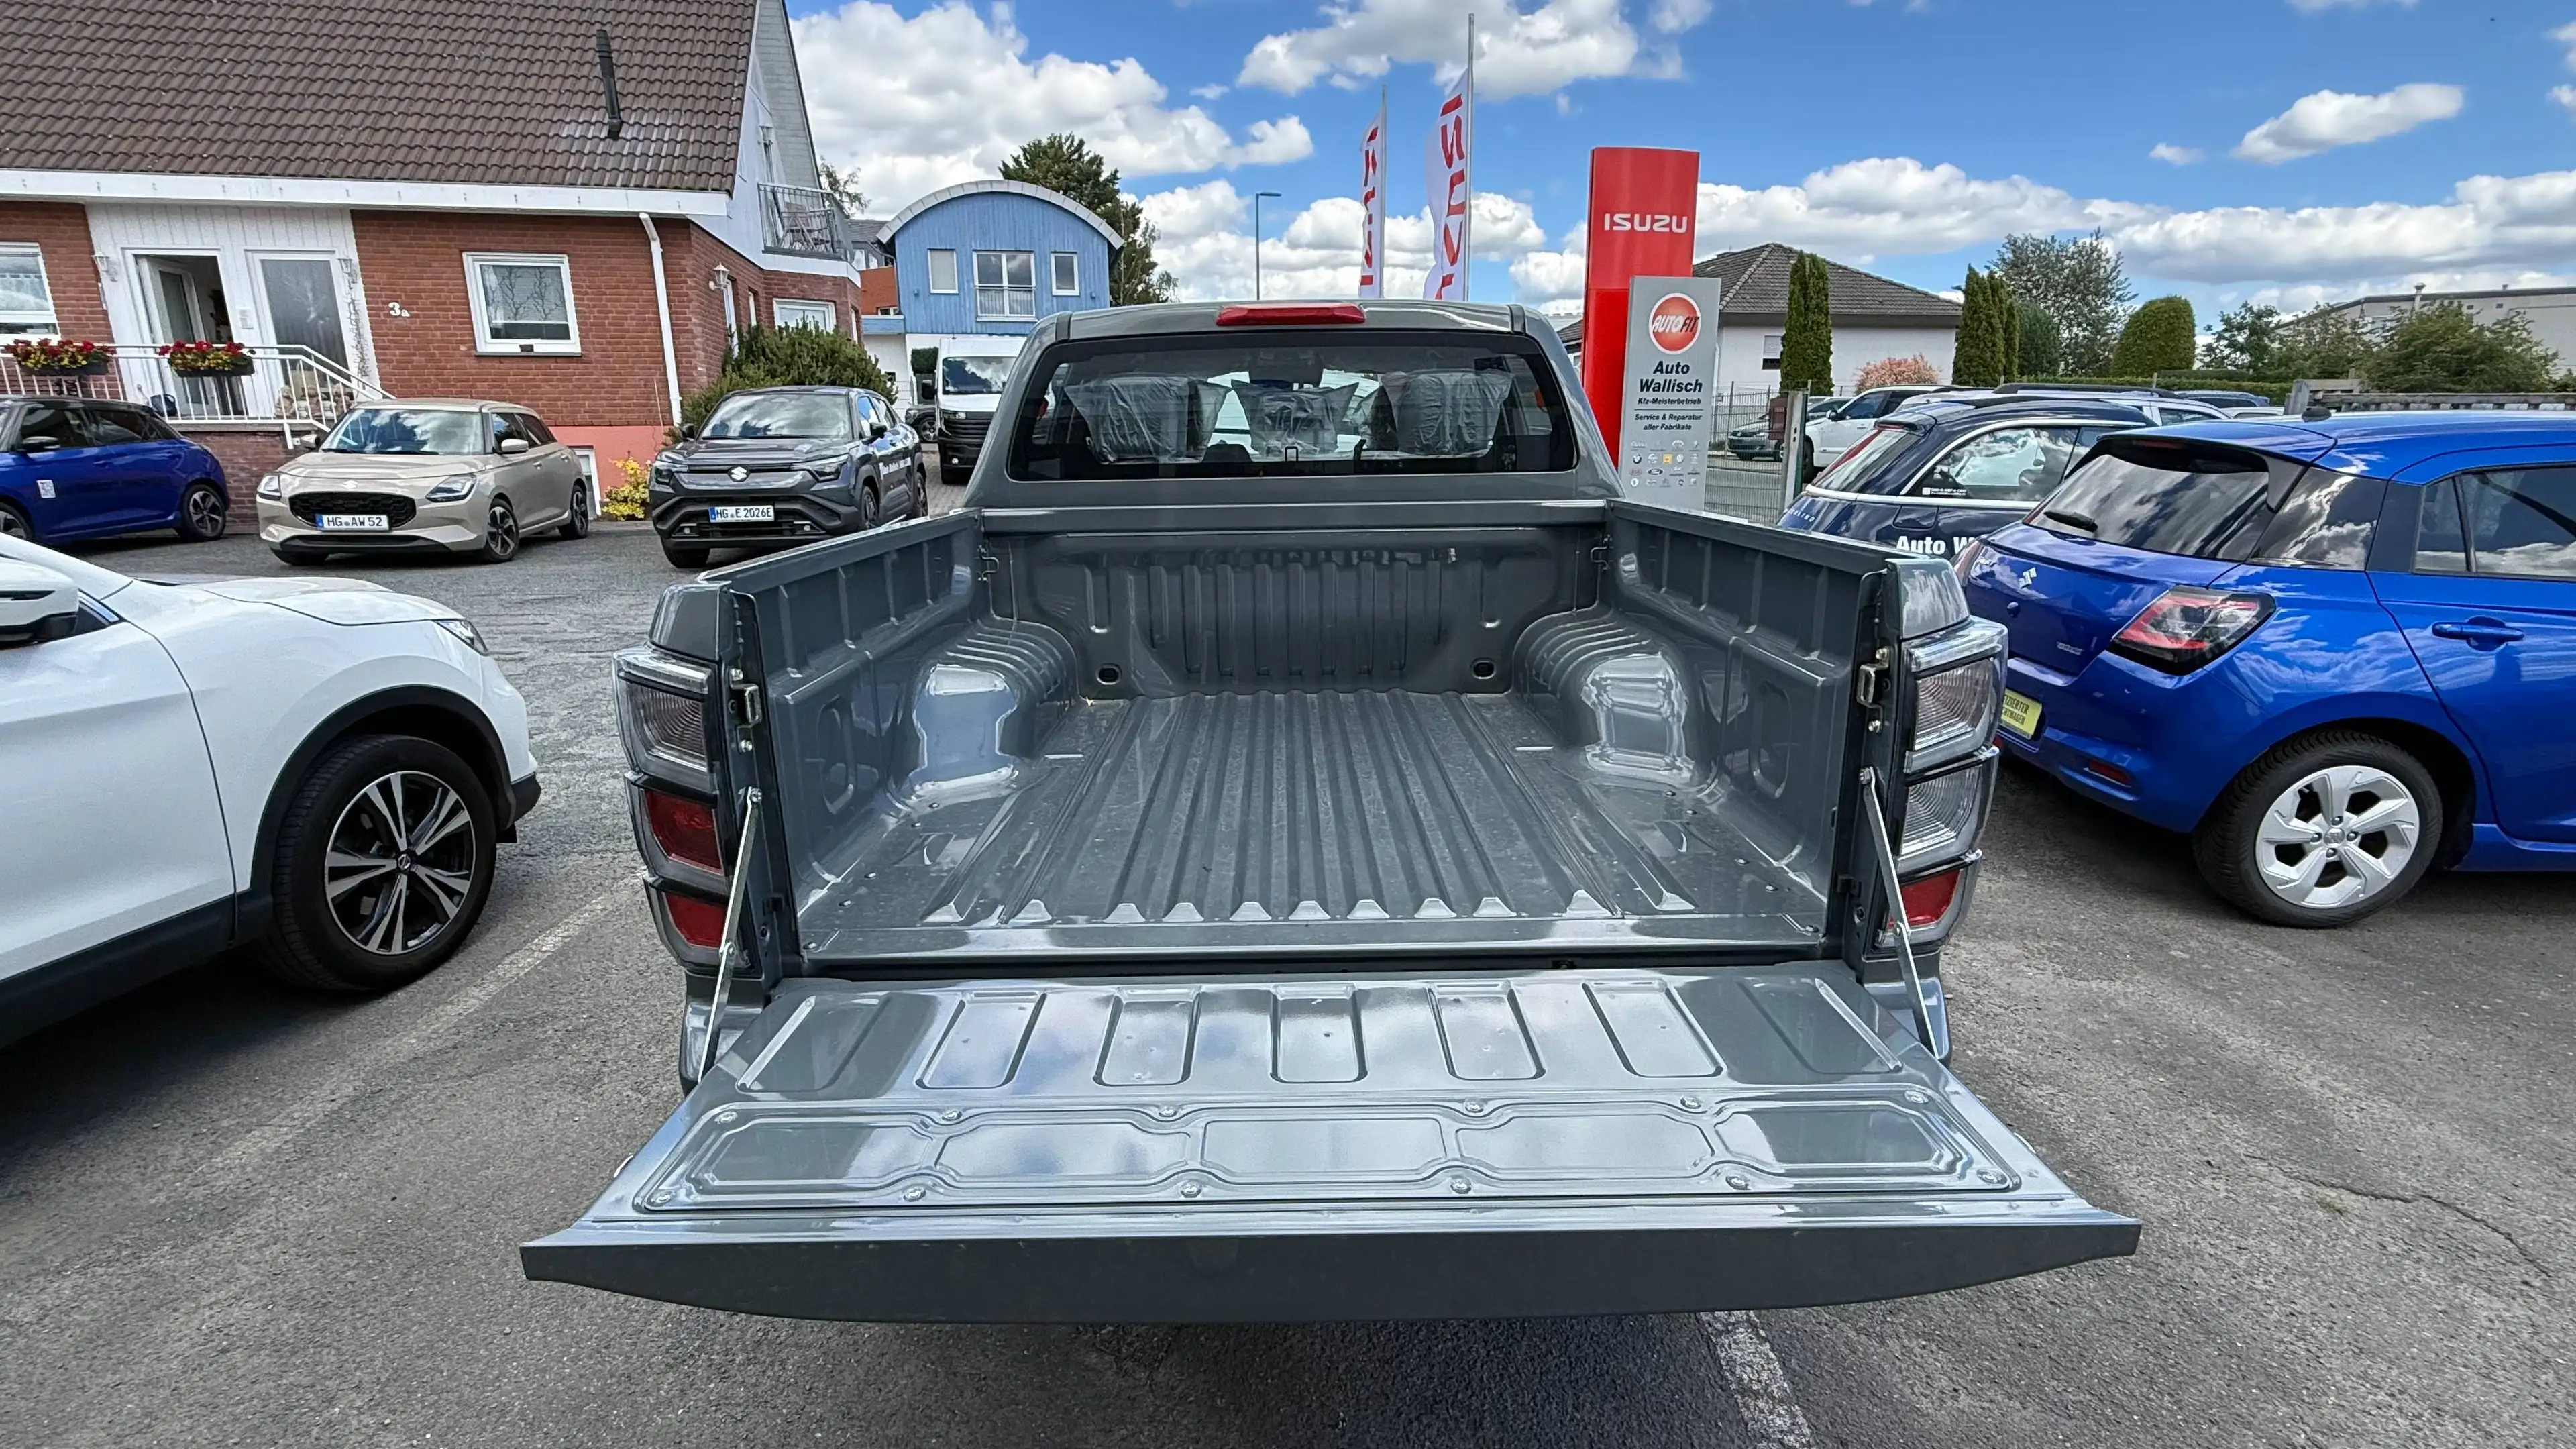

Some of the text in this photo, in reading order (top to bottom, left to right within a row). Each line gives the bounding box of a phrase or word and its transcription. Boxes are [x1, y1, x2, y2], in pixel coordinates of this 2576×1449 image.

[1604, 213, 1688, 233] ISUZU
[1653, 360, 1690, 374] Auto
[1640, 378, 1703, 392] Wallisch
[1668, 413, 1703, 422] Reparatur
[327, 517, 383, 527] HG AW 52
[1896, 535, 1946, 555] Auto
